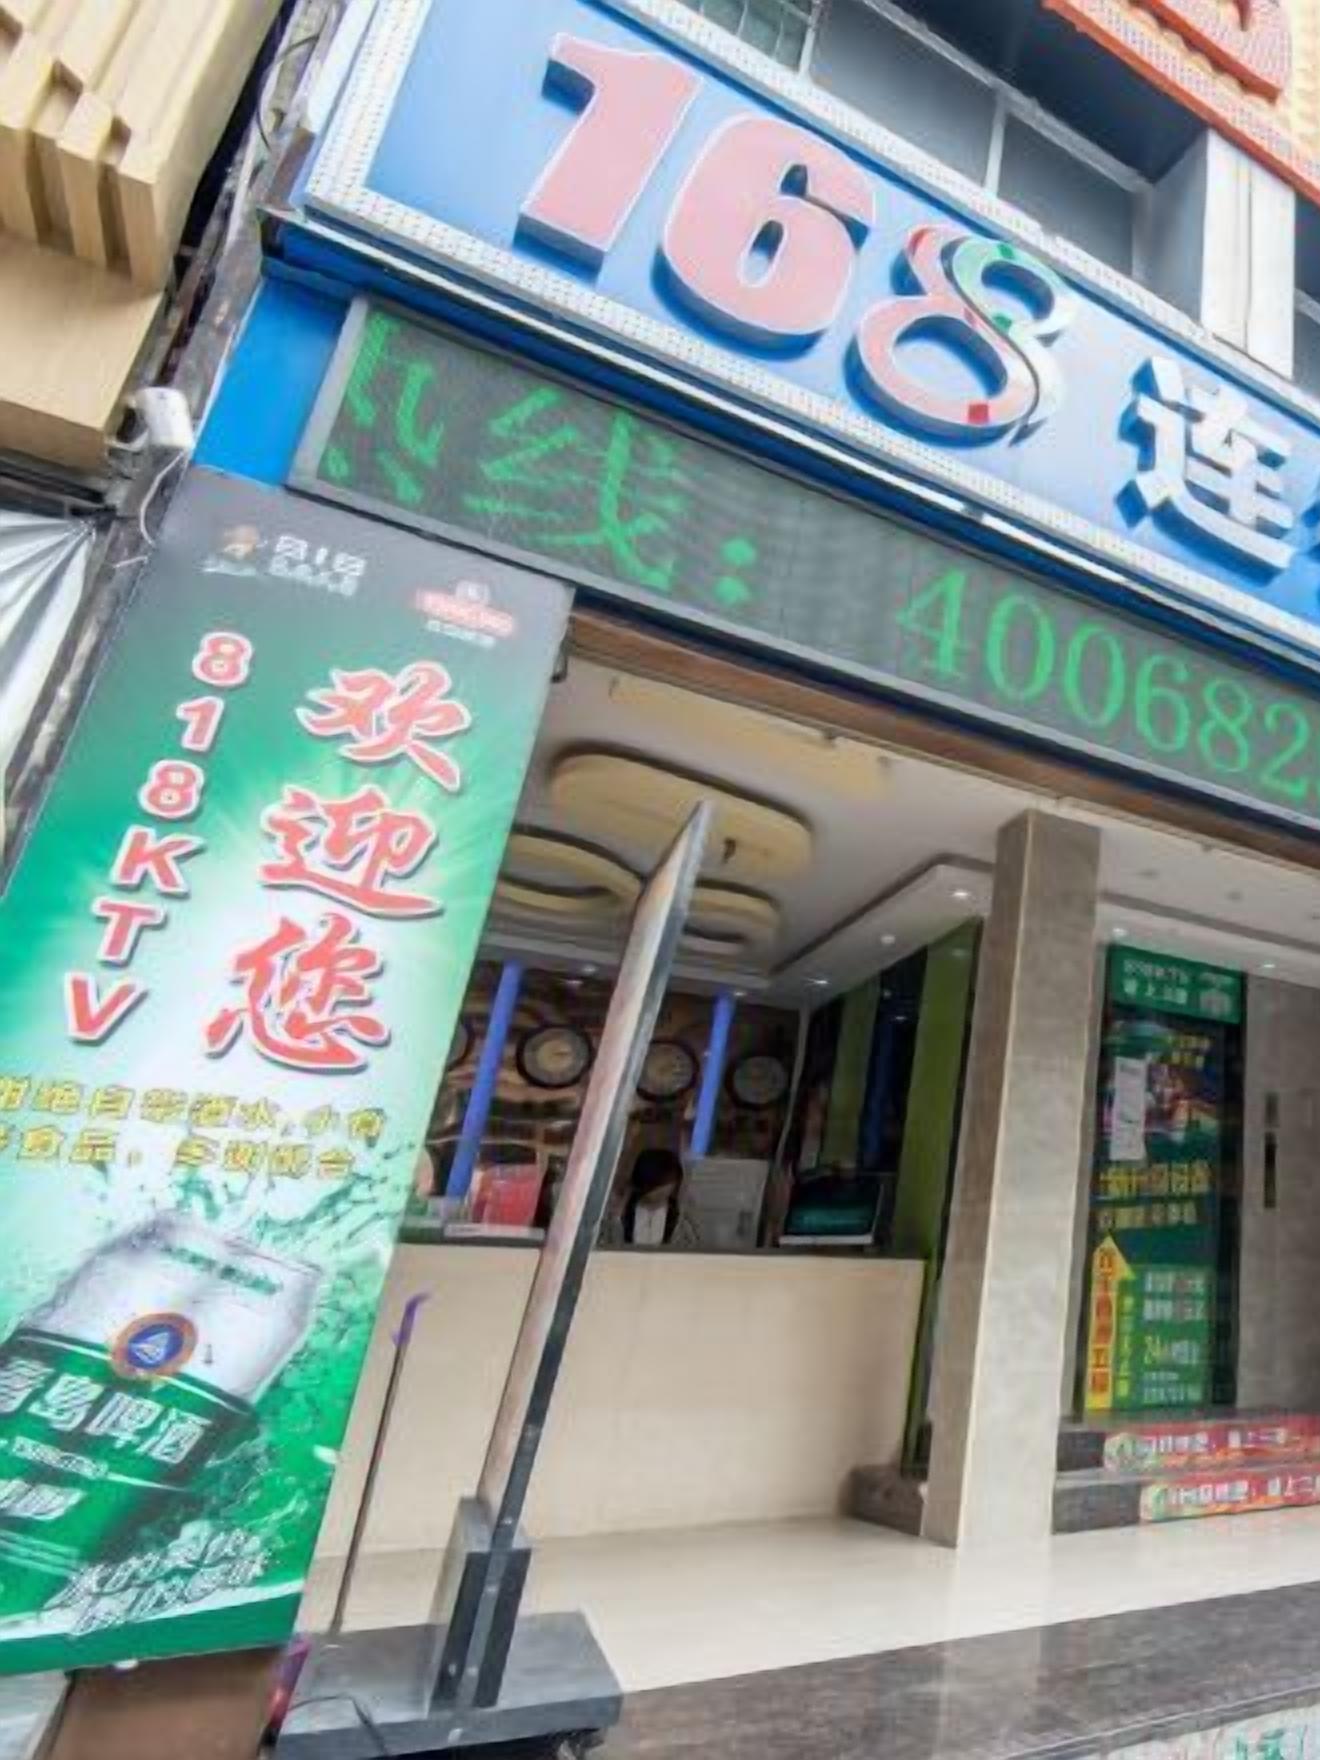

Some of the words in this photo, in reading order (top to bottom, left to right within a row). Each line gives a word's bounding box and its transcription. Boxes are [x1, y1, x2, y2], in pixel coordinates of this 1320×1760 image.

[515, 32, 1068, 432] 168
[200, 660, 473, 1073] 欢迎您
